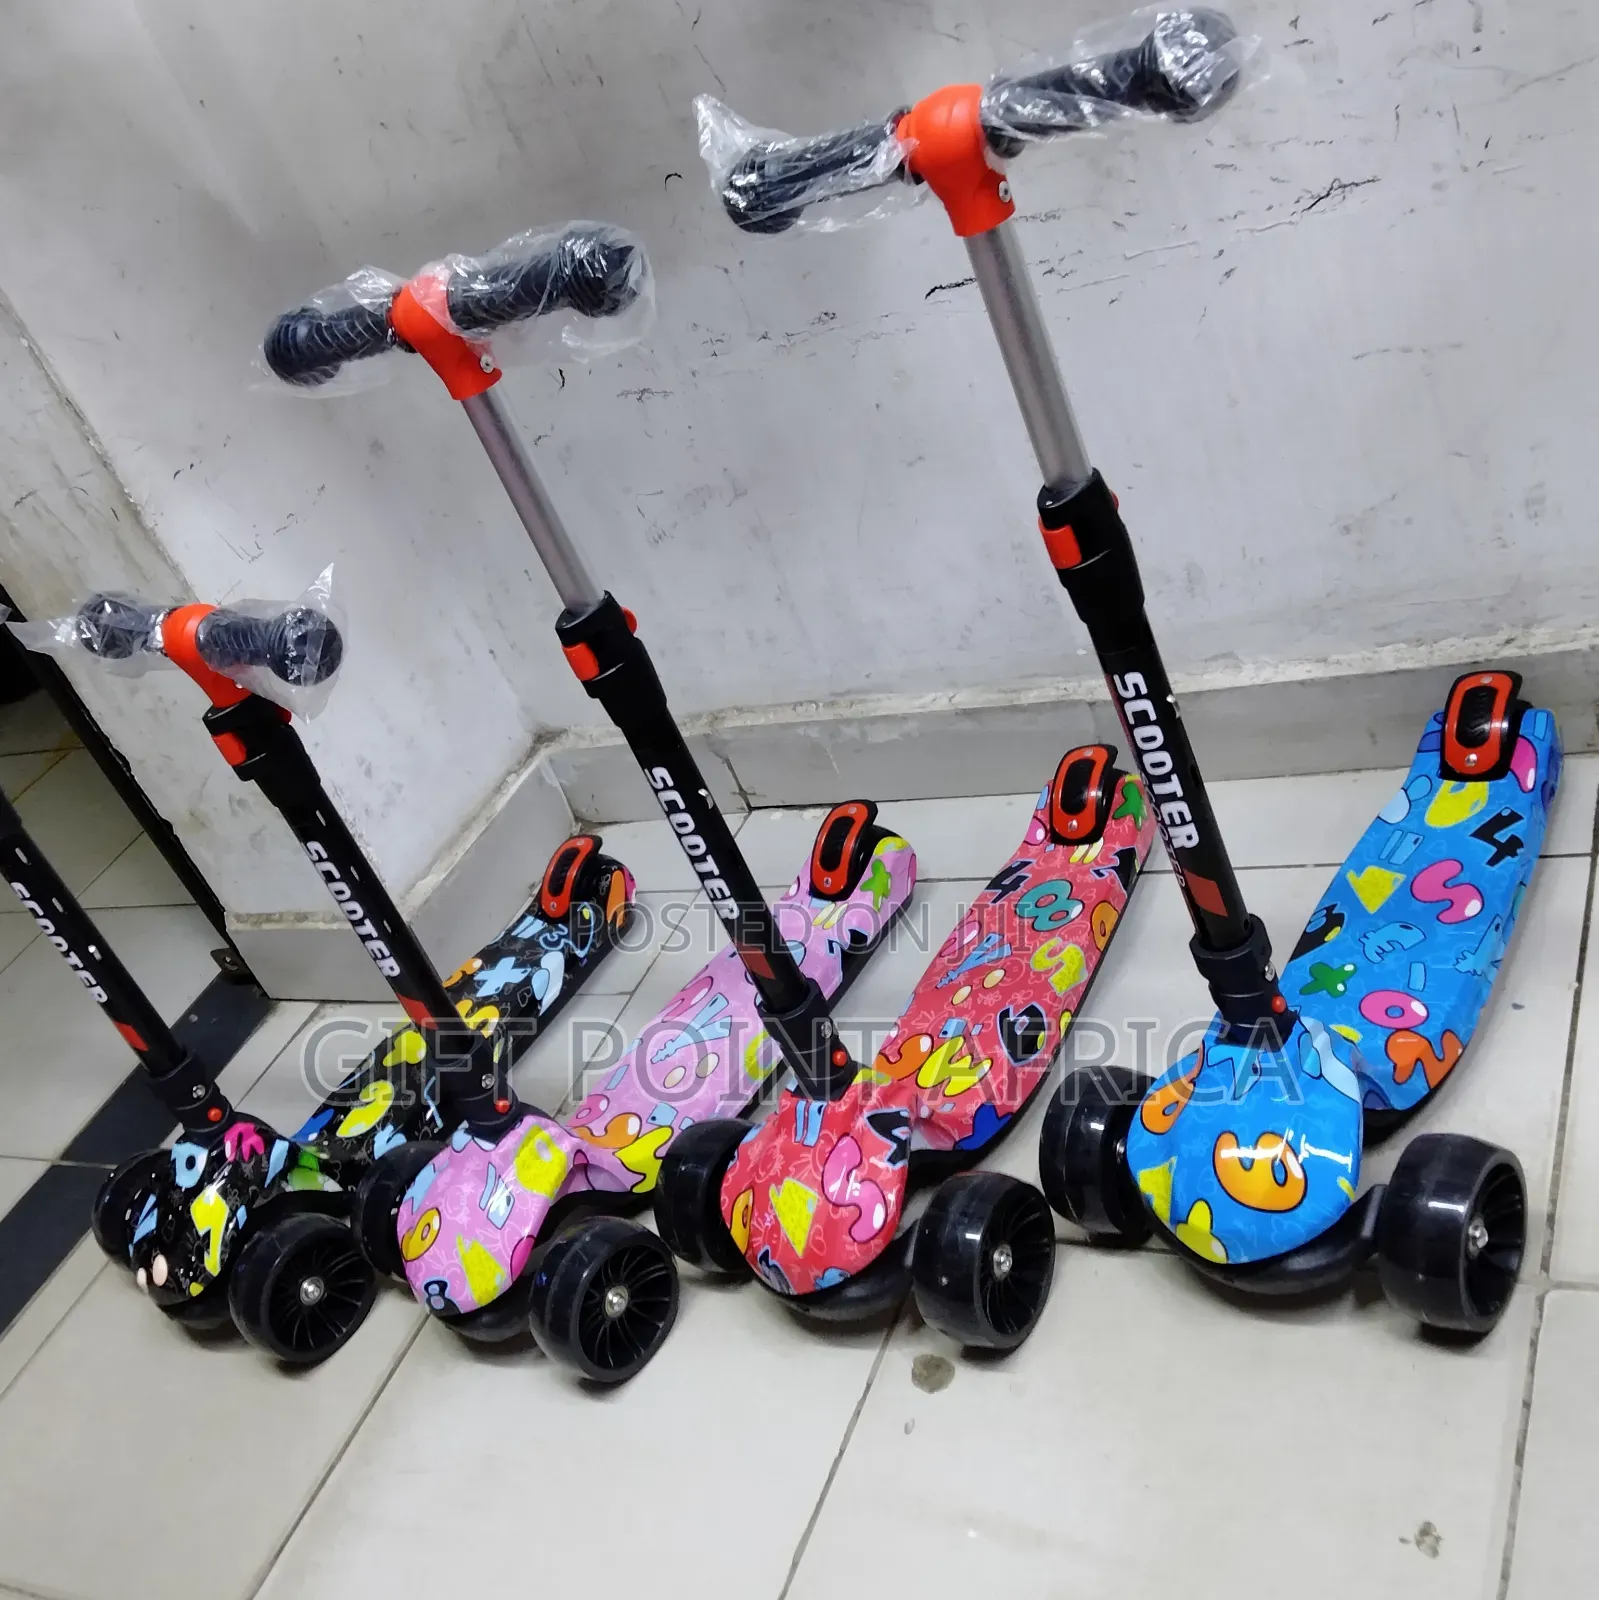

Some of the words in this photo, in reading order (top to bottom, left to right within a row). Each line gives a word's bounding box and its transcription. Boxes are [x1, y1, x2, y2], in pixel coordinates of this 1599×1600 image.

[1113, 671, 1200, 850] SCOOTER
[300, 840, 401, 978] SCOOTER
[644, 766, 740, 920] SCOOTER
